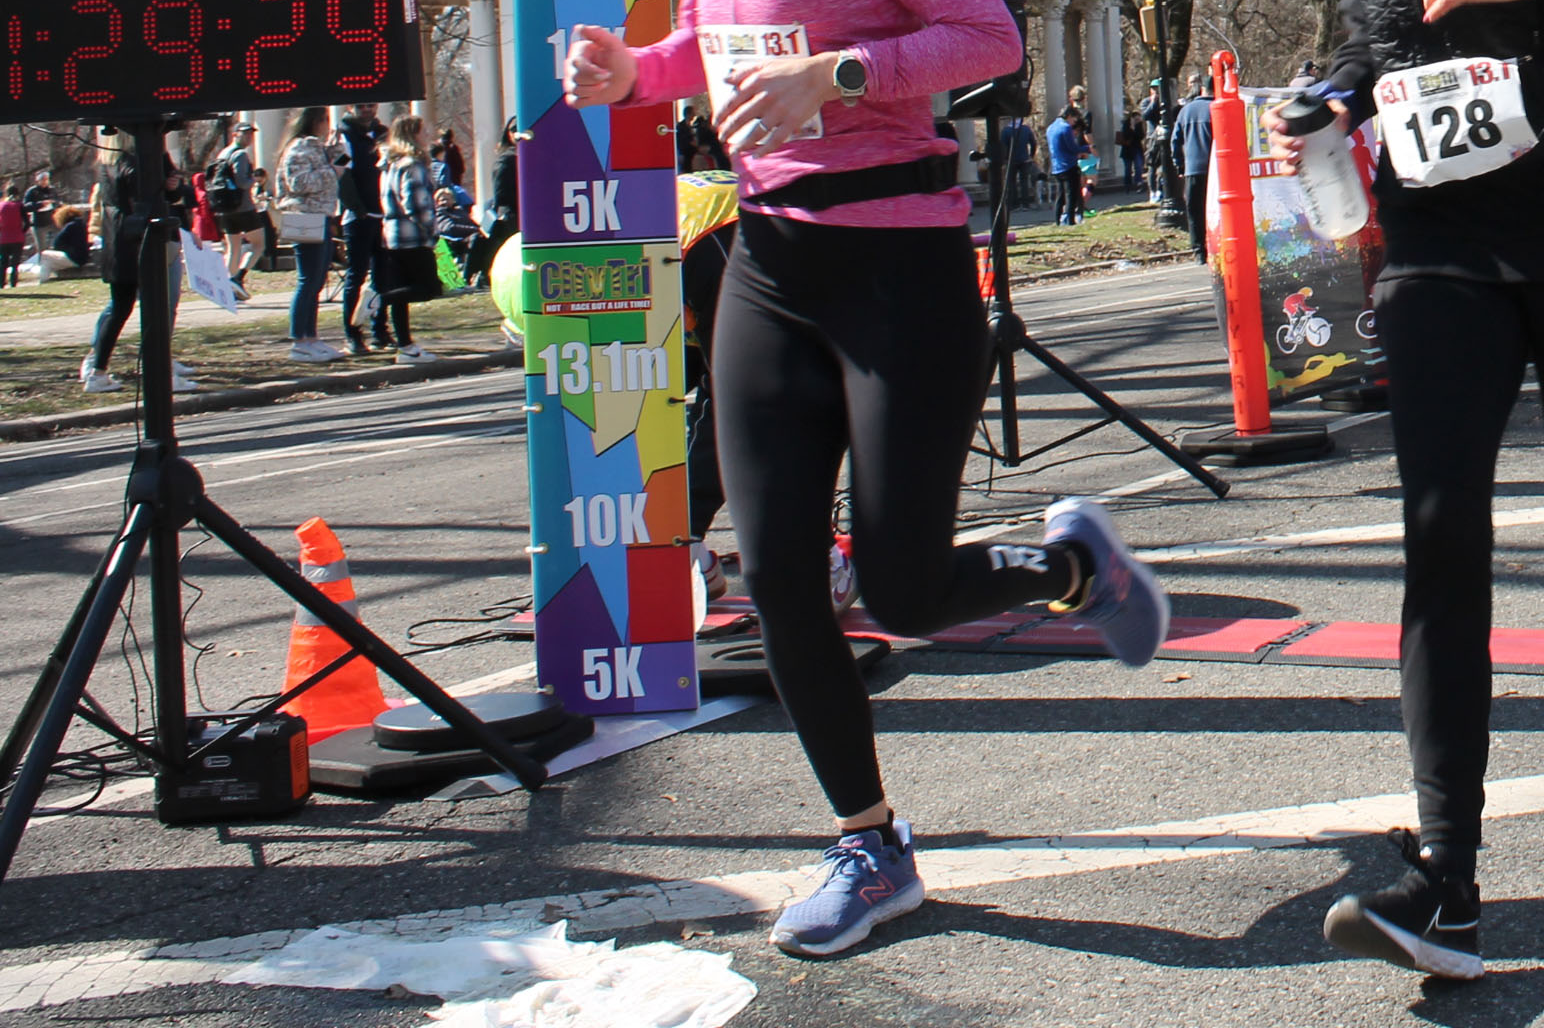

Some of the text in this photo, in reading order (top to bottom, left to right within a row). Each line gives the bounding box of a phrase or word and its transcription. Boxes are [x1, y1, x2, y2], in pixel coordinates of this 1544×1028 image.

[761, 29, 799, 56] 13.1
[1466, 61, 1512, 86] 13.1
[1405, 99, 1503, 163] 128
[563, 179, 621, 233] 5K
[539, 257, 653, 300] CityTri
[538, 341, 669, 396] 13.1m
[564, 492, 651, 548] 10K
[583, 646, 646, 701] 5K
